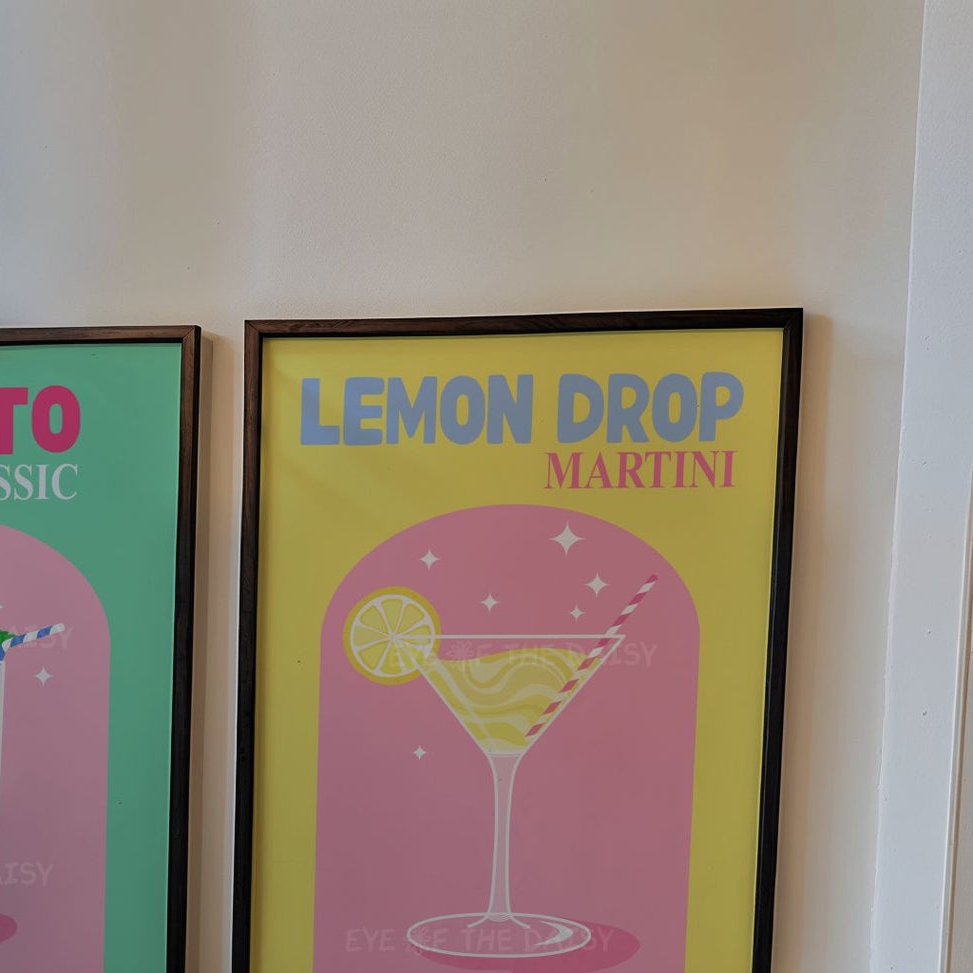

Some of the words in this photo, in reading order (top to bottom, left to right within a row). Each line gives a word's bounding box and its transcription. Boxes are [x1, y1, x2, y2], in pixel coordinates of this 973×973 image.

[300, 374, 534, 446] LEMON
[557, 372, 744, 443] DROP
[543, 450, 736, 489] MARTINI
